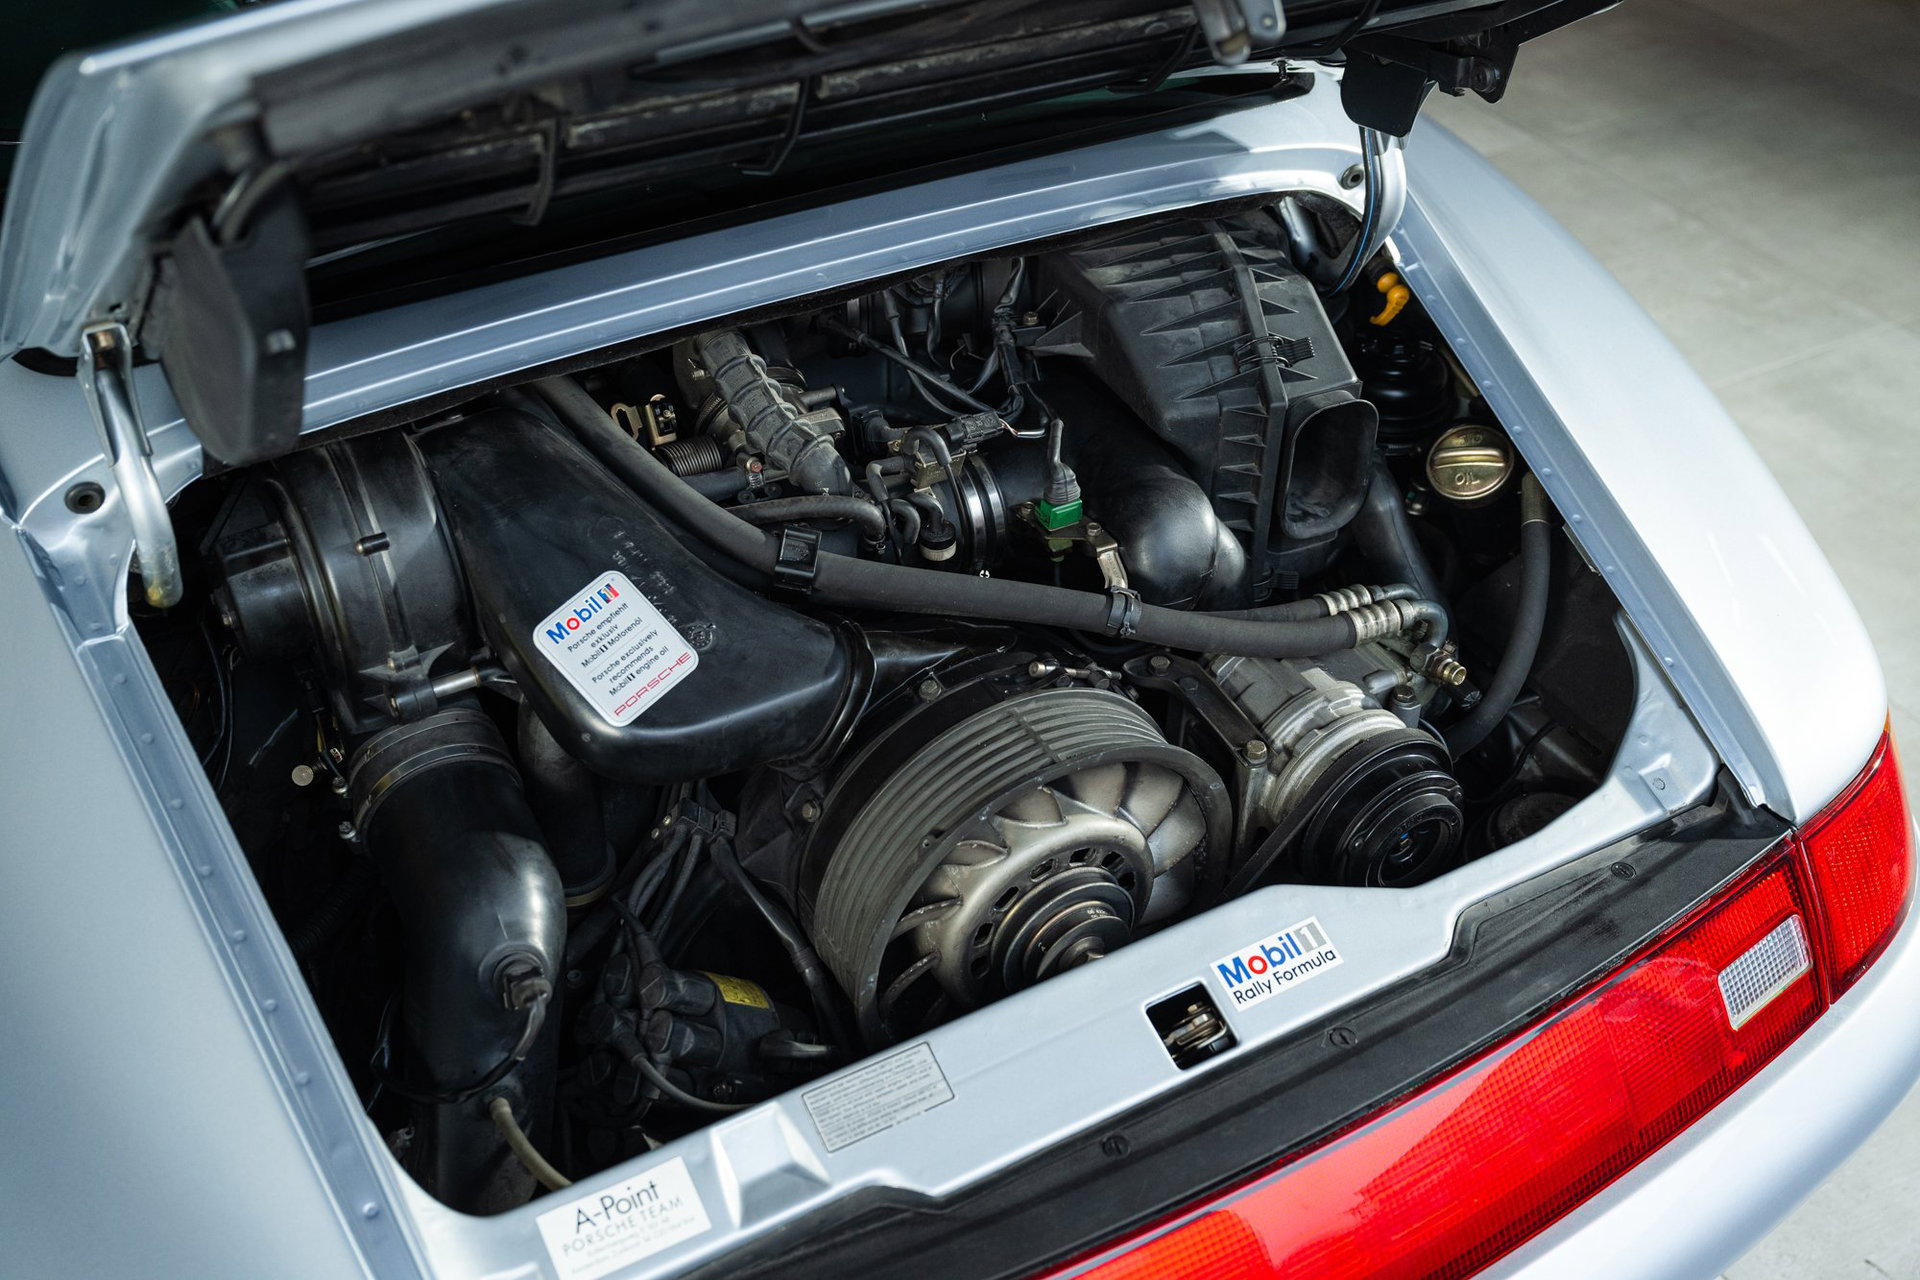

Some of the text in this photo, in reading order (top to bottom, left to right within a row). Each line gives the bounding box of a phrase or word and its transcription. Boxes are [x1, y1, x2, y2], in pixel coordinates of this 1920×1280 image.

[1455, 472, 1480, 485] OIL
[567, 603, 628, 652] Porsche empfiehlt
[590, 625, 618, 648] exklusiv
[607, 617, 643, 647] Motorenöl
[592, 630, 658, 683] Porsche exclusively
[609, 646, 654, 683] recommends
[635, 655, 660, 675] engine
[660, 647, 669, 656] oil
[614, 652, 691, 716] PORSCHE
[1233, 950, 1336, 1004] Rally Formula
[562, 1216, 638, 1255] PORSCHE
[641, 1197, 683, 1222] TEAM
[575, 1180, 659, 1233] A-Point
